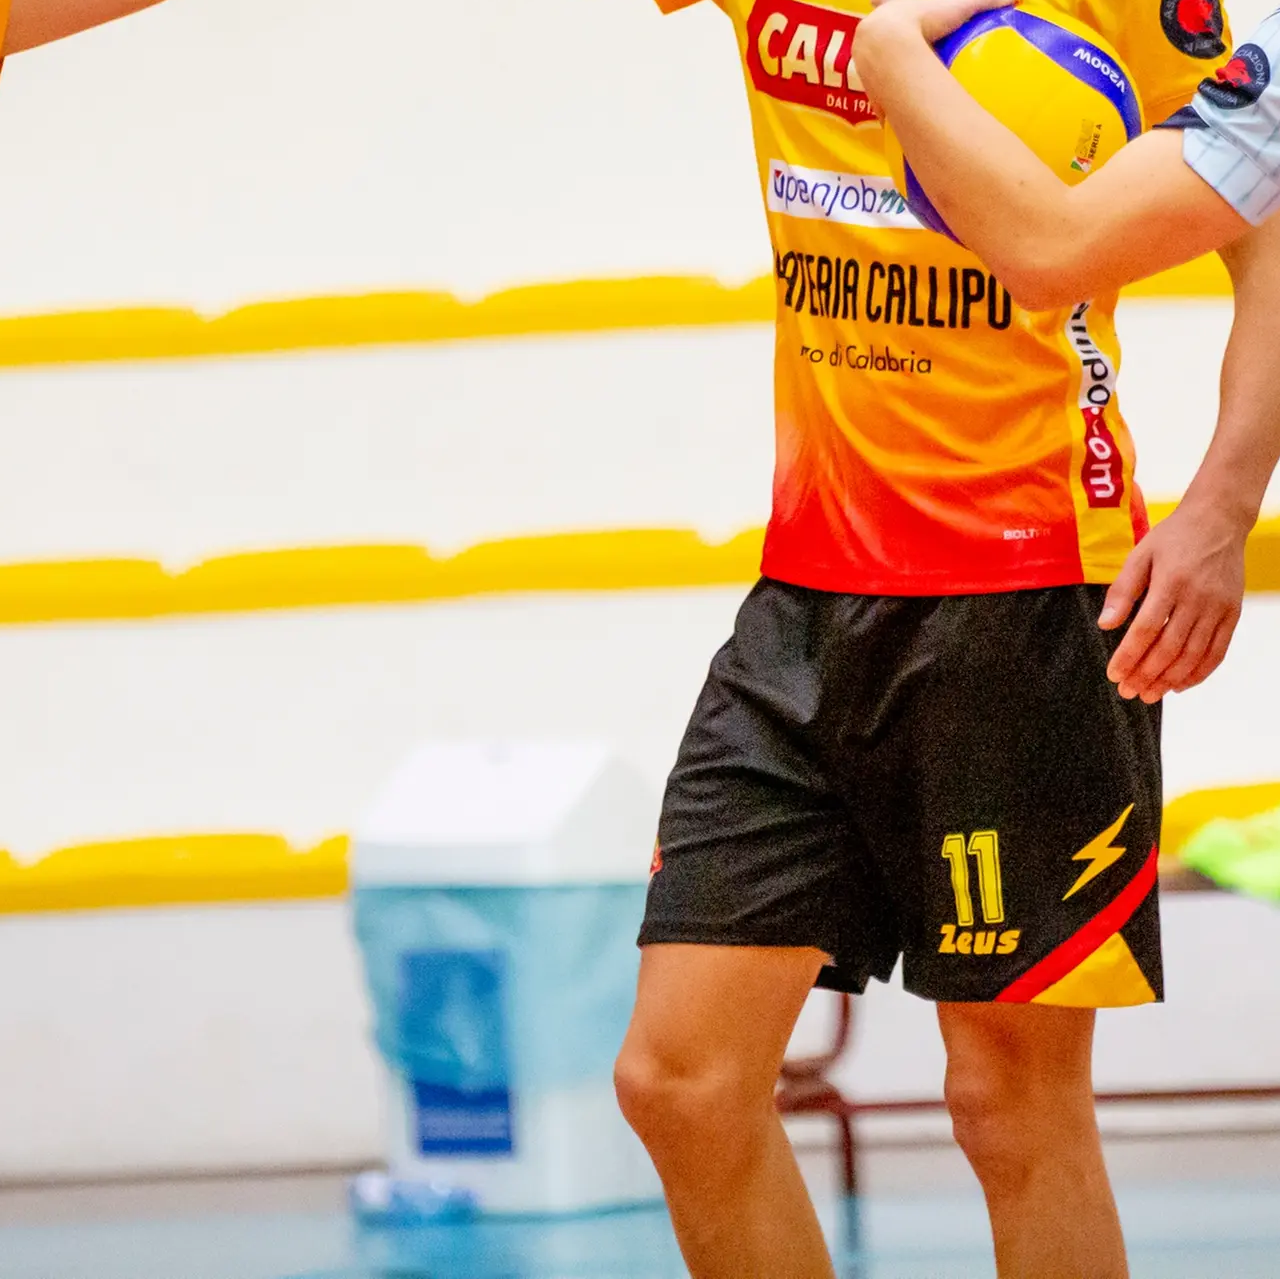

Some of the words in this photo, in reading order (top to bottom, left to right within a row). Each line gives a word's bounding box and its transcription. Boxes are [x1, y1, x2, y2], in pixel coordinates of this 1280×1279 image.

[1073, 48, 1126, 93] V200W
[825, 93, 849, 111] DAL
[1087, 132, 1101, 160] SERIE
[866, 260, 1012, 331] CALLIPO
[829, 340, 843, 368] di
[845, 344, 932, 374] Calabria
[941, 829, 1006, 927] 11
[937, 922, 1023, 956] Zeus
